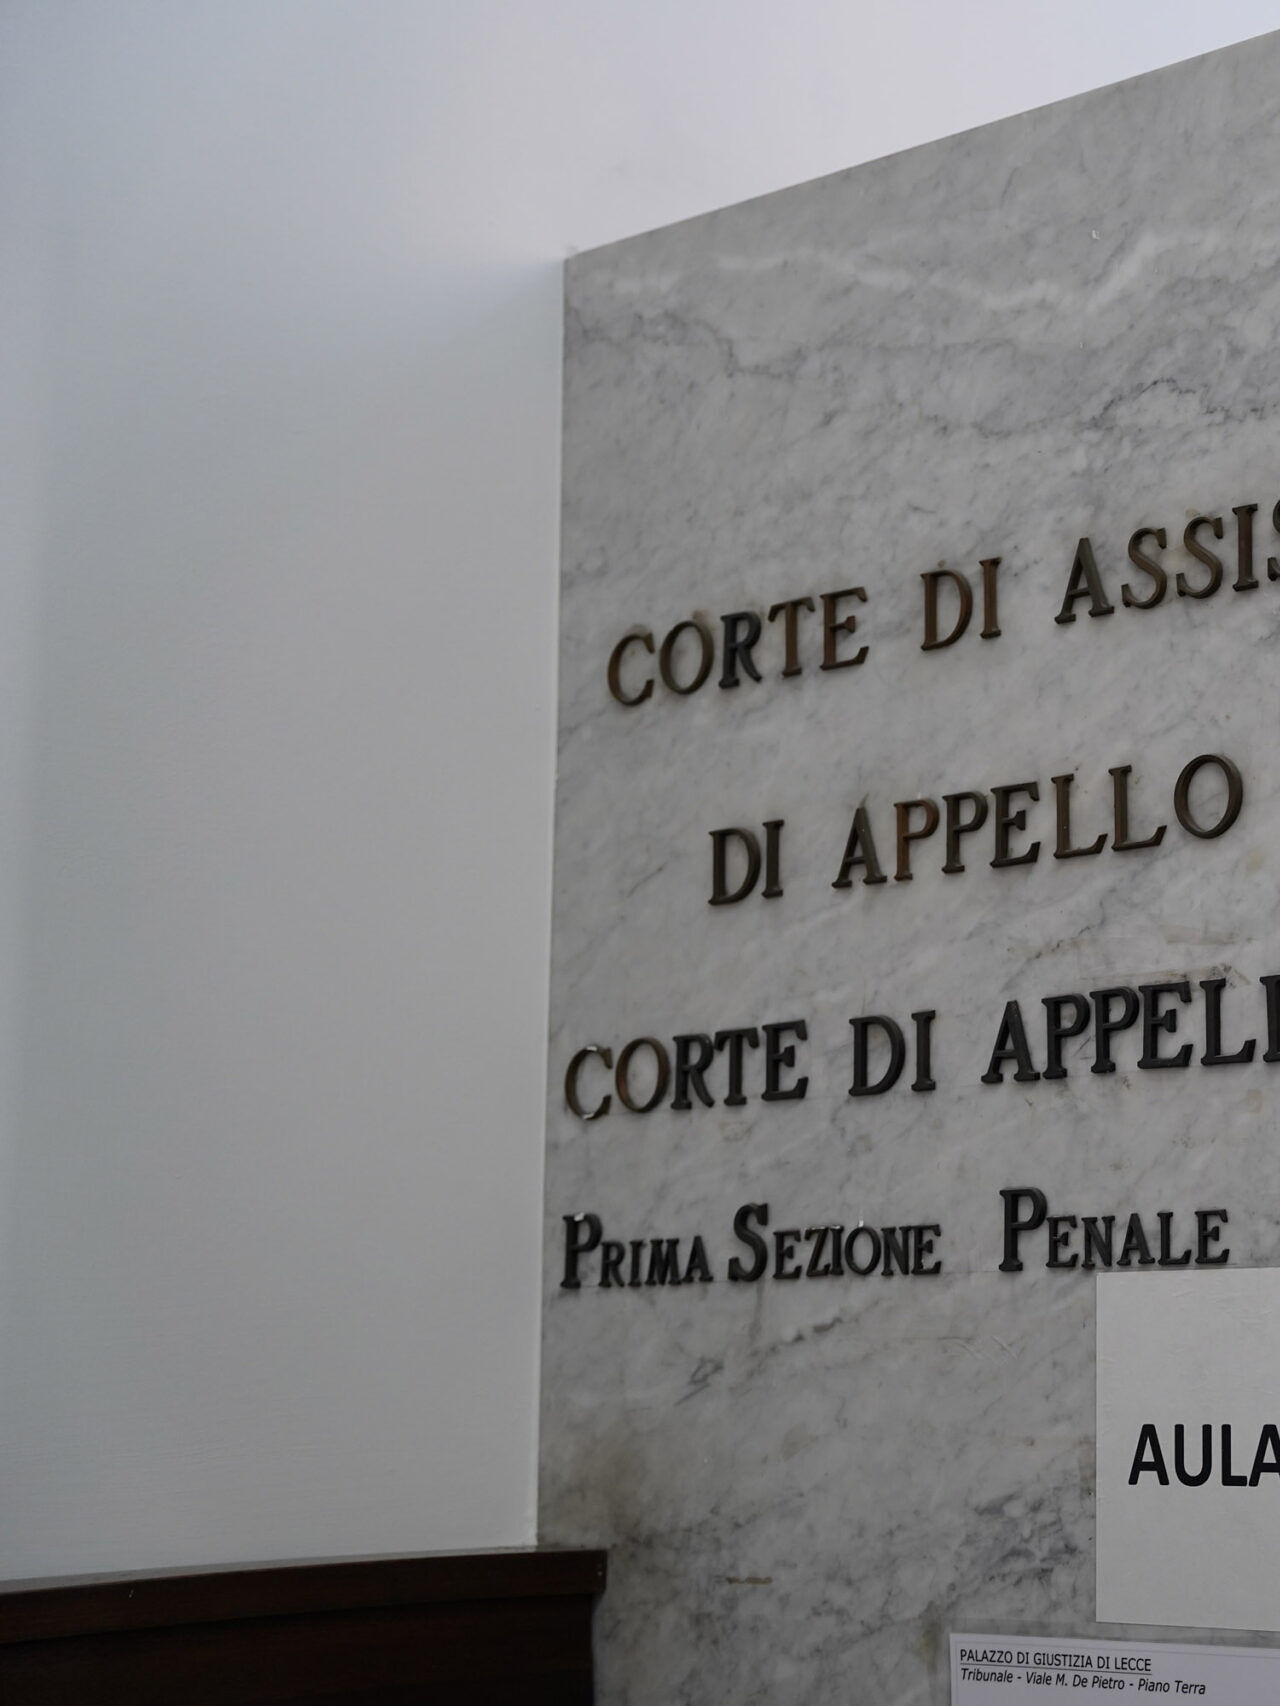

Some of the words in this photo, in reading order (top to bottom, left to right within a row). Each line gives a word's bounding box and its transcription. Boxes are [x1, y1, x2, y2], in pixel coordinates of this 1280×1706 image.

[607, 586, 869, 709] CORTE
[919, 557, 1002, 652] DI
[707, 819, 785, 907] DI
[831, 754, 1244, 890] APPELLO
[564, 1020, 808, 1122] CORTE
[849, 1010, 936, 1098] DI
[960, 1649, 1013, 1664] PALAZZO
[1016, 1652, 1030, 1665] DI
[1033, 1653, 1093, 1669] GIUSTIZIA
[1097, 1656, 1110, 1669] DI
[1114, 1657, 1152, 1671] LECCE
[960, 1668, 1013, 1683] Tribunale
[1026, 1671, 1052, 1685] Viale
[1055, 1673, 1068, 1687] M.
[1073, 1674, 1088, 1688] De
[1091, 1675, 1125, 1690] Pietro
[1138, 1678, 1170, 1692] Piano
[1174, 1680, 1206, 1695] Terra
